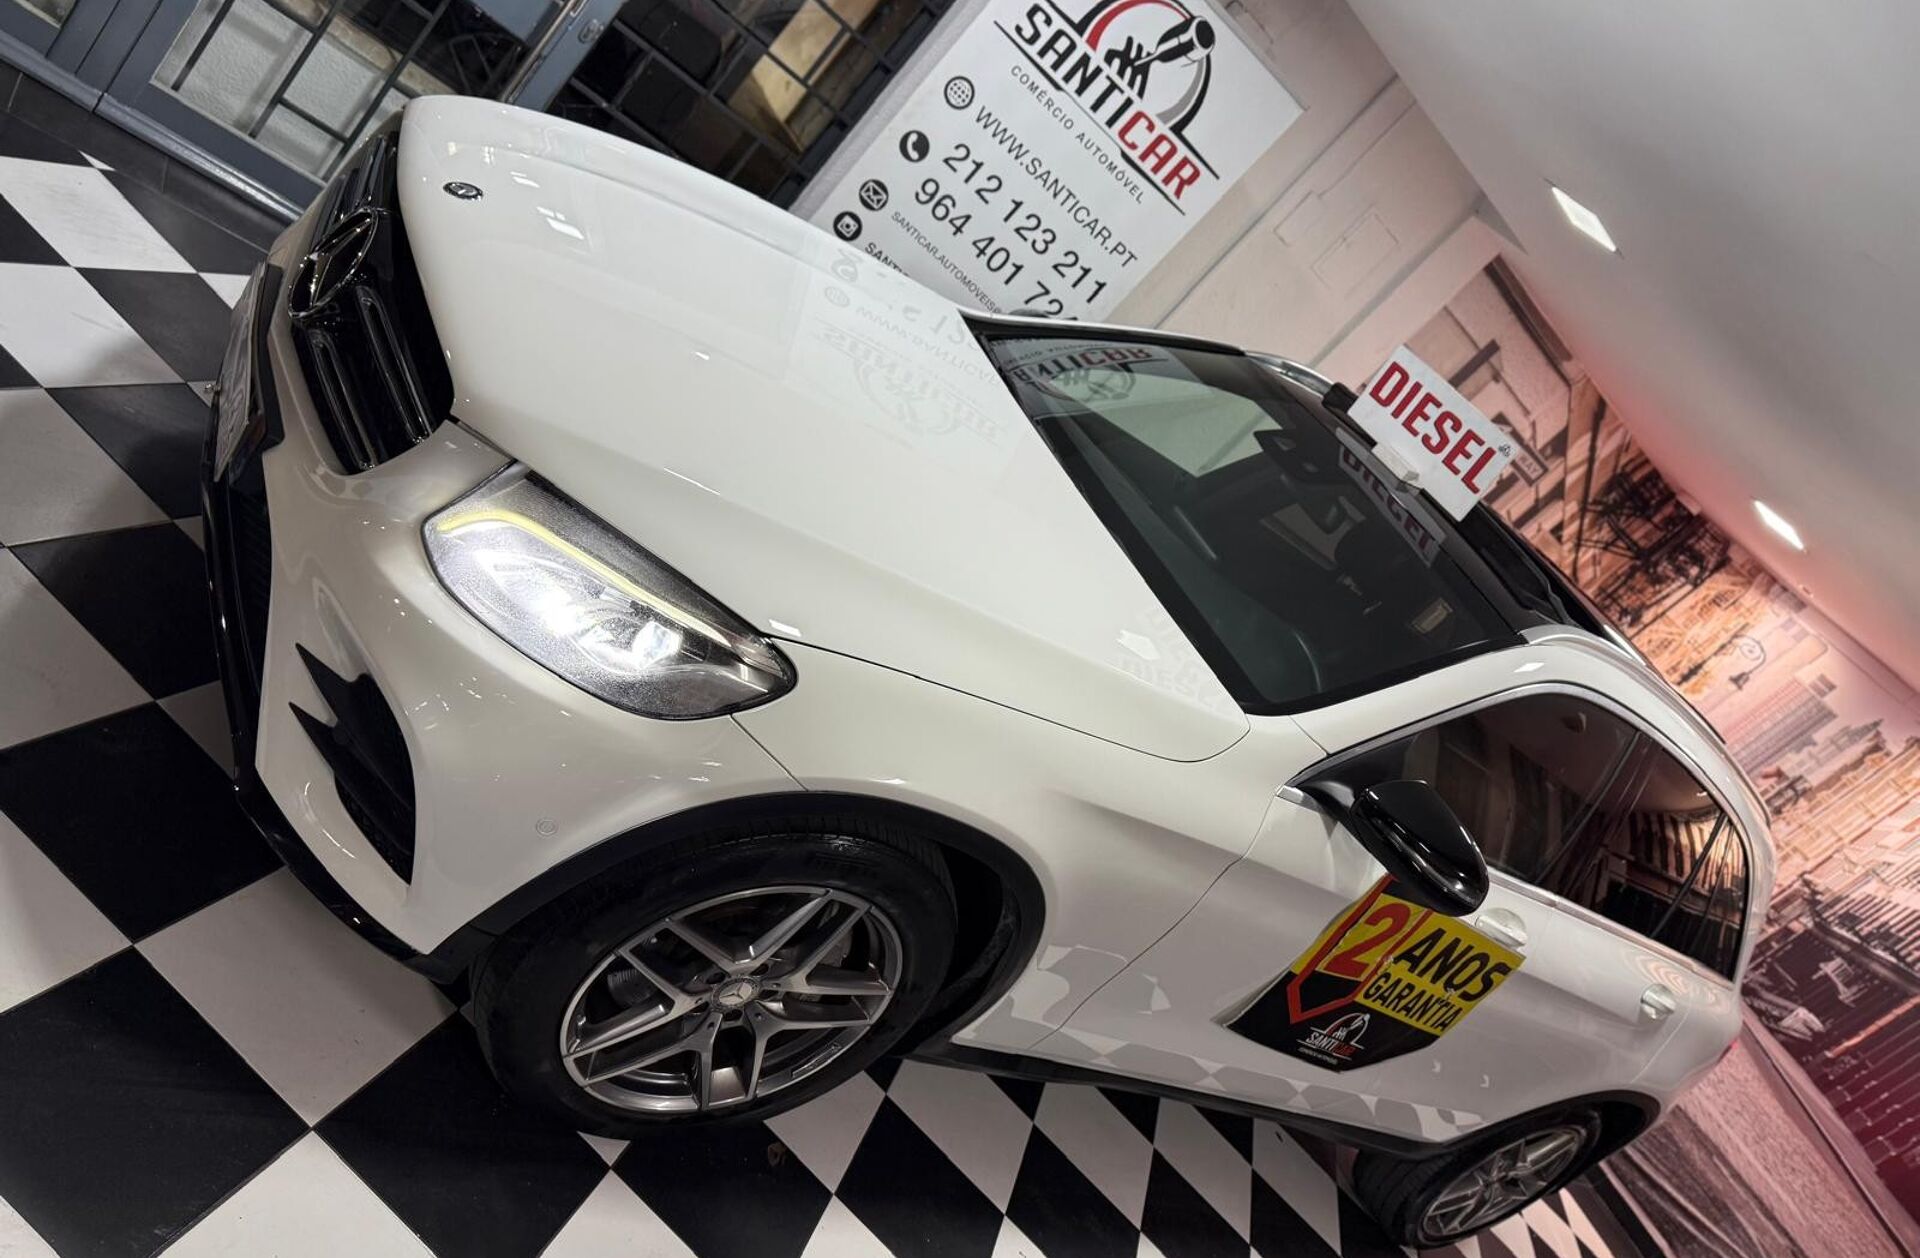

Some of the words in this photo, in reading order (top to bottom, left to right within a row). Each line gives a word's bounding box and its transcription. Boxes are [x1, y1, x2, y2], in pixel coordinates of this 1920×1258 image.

[1010, 65, 1074, 130] COMÉRCIO
[1074, 131, 1144, 204] AUTOMÓVEL
[1014, 3, 1201, 199] SANTICAR
[914, 178, 972, 238] 964
[972, 236, 1025, 287] 401
[1023, 280, 1078, 321] 72
[943, 143, 1003, 204] 212
[1002, 198, 1057, 256] 123
[1052, 250, 1107, 305] 211
[975, 105, 1138, 268] WWW.SANTICAR.PT
[1369, 361, 1497, 494] DIESEL
[1325, 902, 1411, 979] 2
[1393, 928, 1512, 1002] ANOS
[1363, 972, 1463, 1030] GARANTIA
